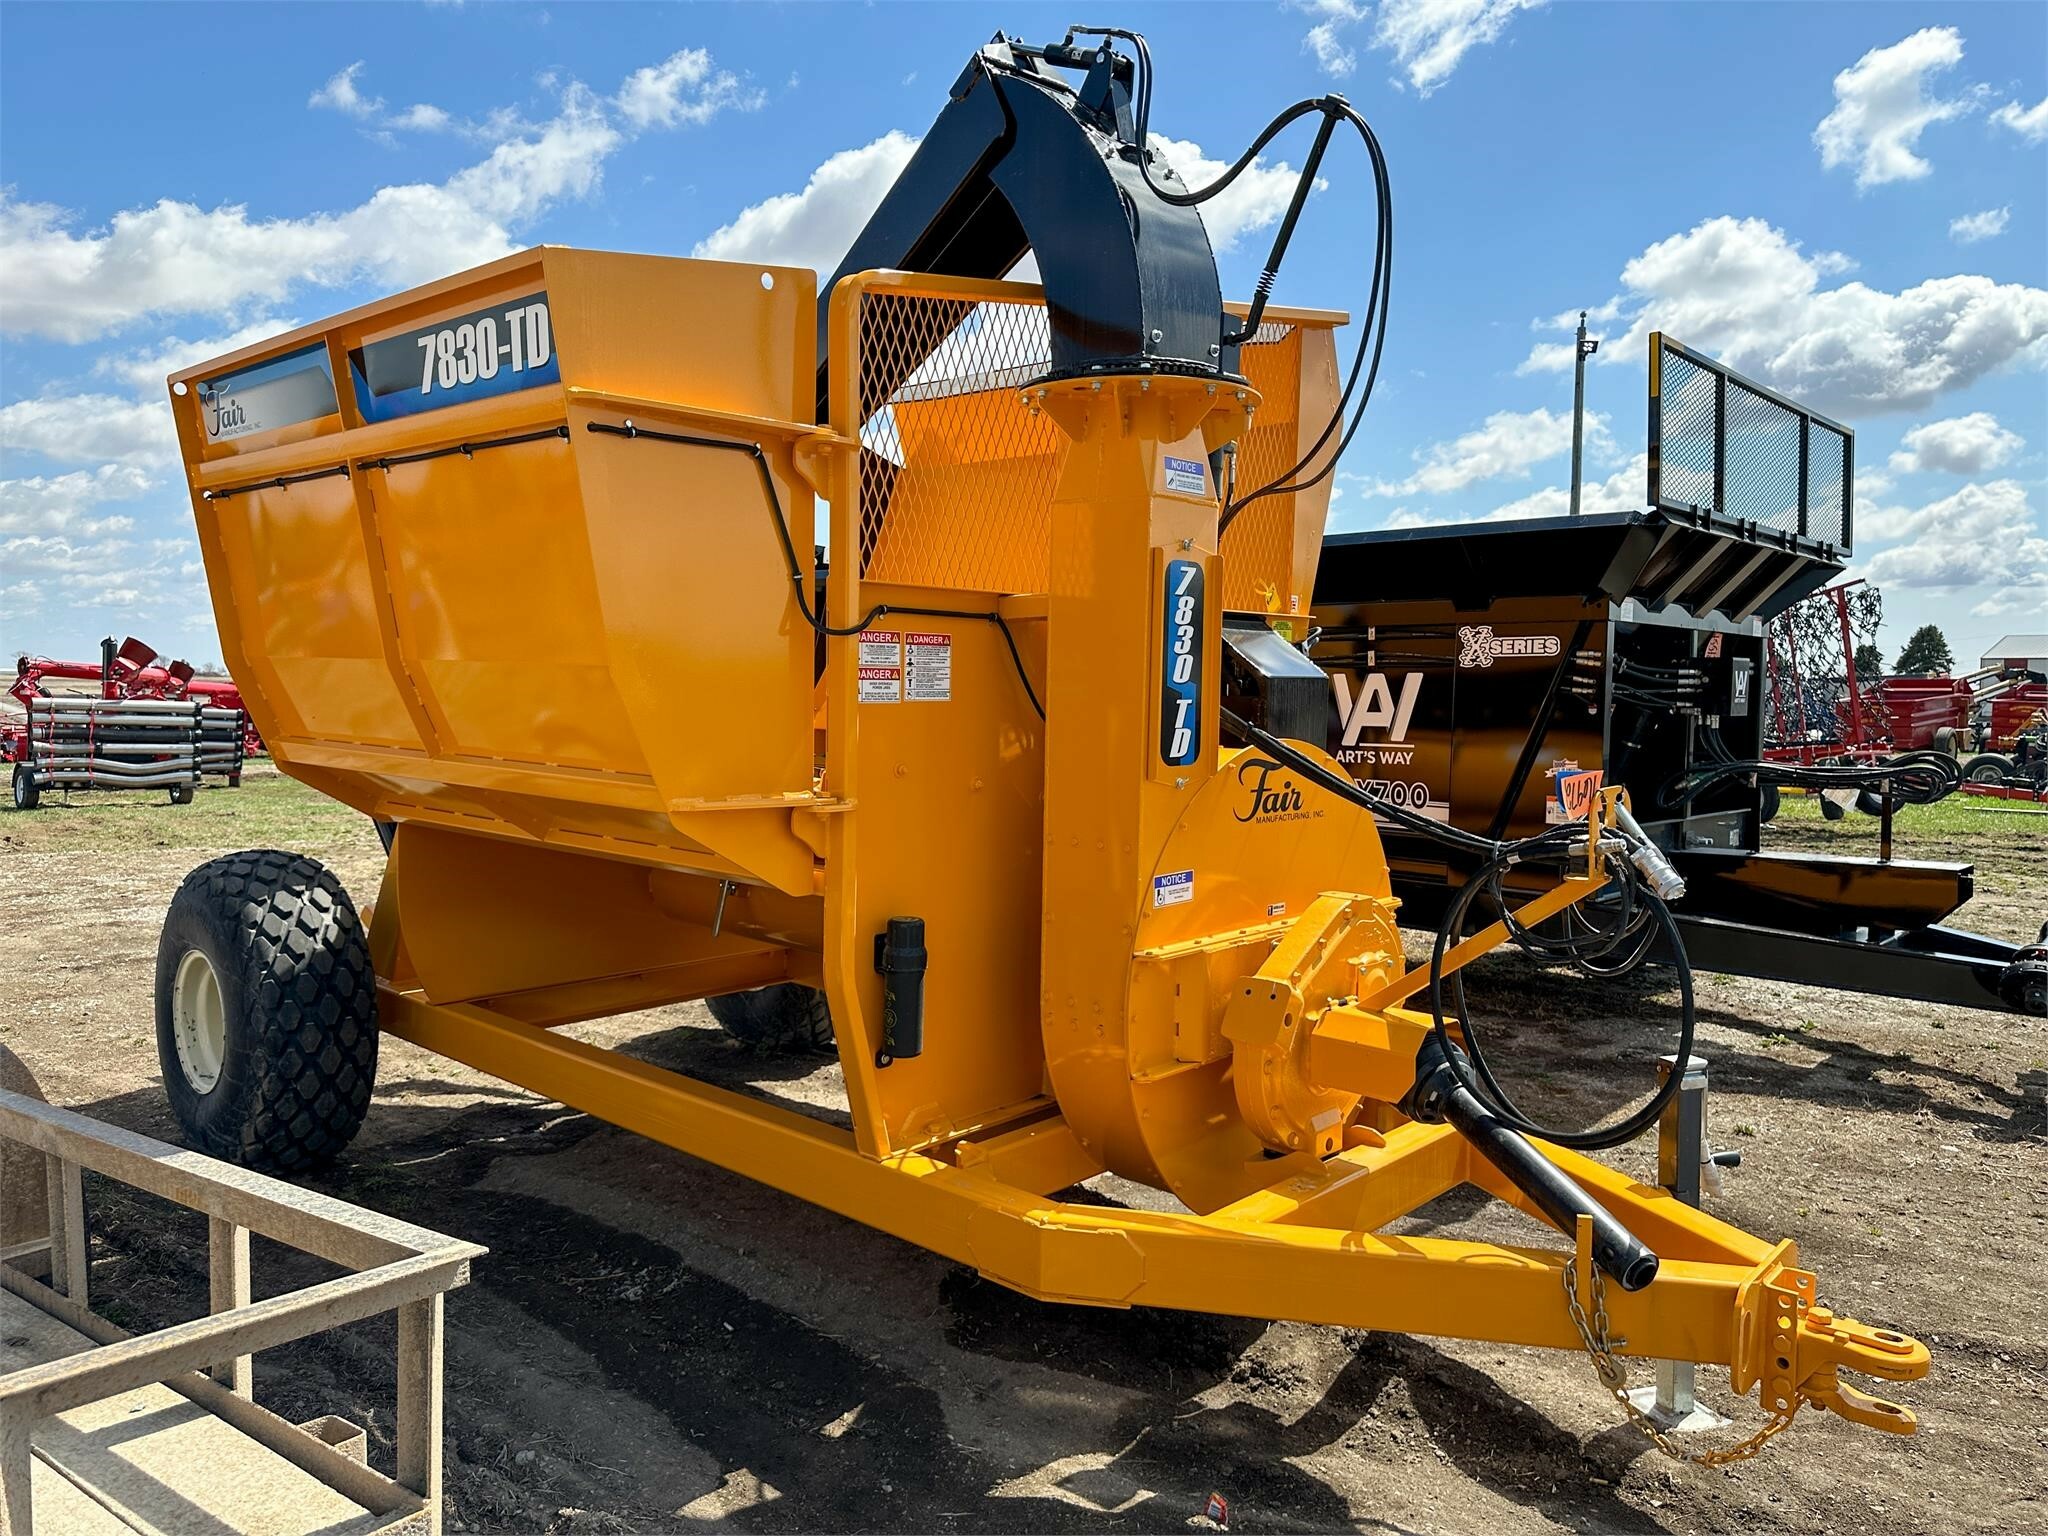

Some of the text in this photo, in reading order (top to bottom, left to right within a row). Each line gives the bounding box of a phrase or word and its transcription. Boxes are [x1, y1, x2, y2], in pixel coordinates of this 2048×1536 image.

[417, 302, 550, 394] 7830-TD
[205, 383, 246, 436] Fair
[1171, 459, 1197, 473] NOTICE
[859, 633, 892, 643] ANGER
[913, 635, 943, 645] DANGER
[1489, 638, 1558, 655] SERIES
[1169, 566, 1197, 758] 7830 TD
[859, 669, 892, 679] ANGER
[1336, 750, 1414, 765] ART'S WAY
[1232, 758, 1304, 822] Fair
[1255, 811, 1311, 824] MANUFACTURING,
[1161, 873, 1187, 887] NOTICE
